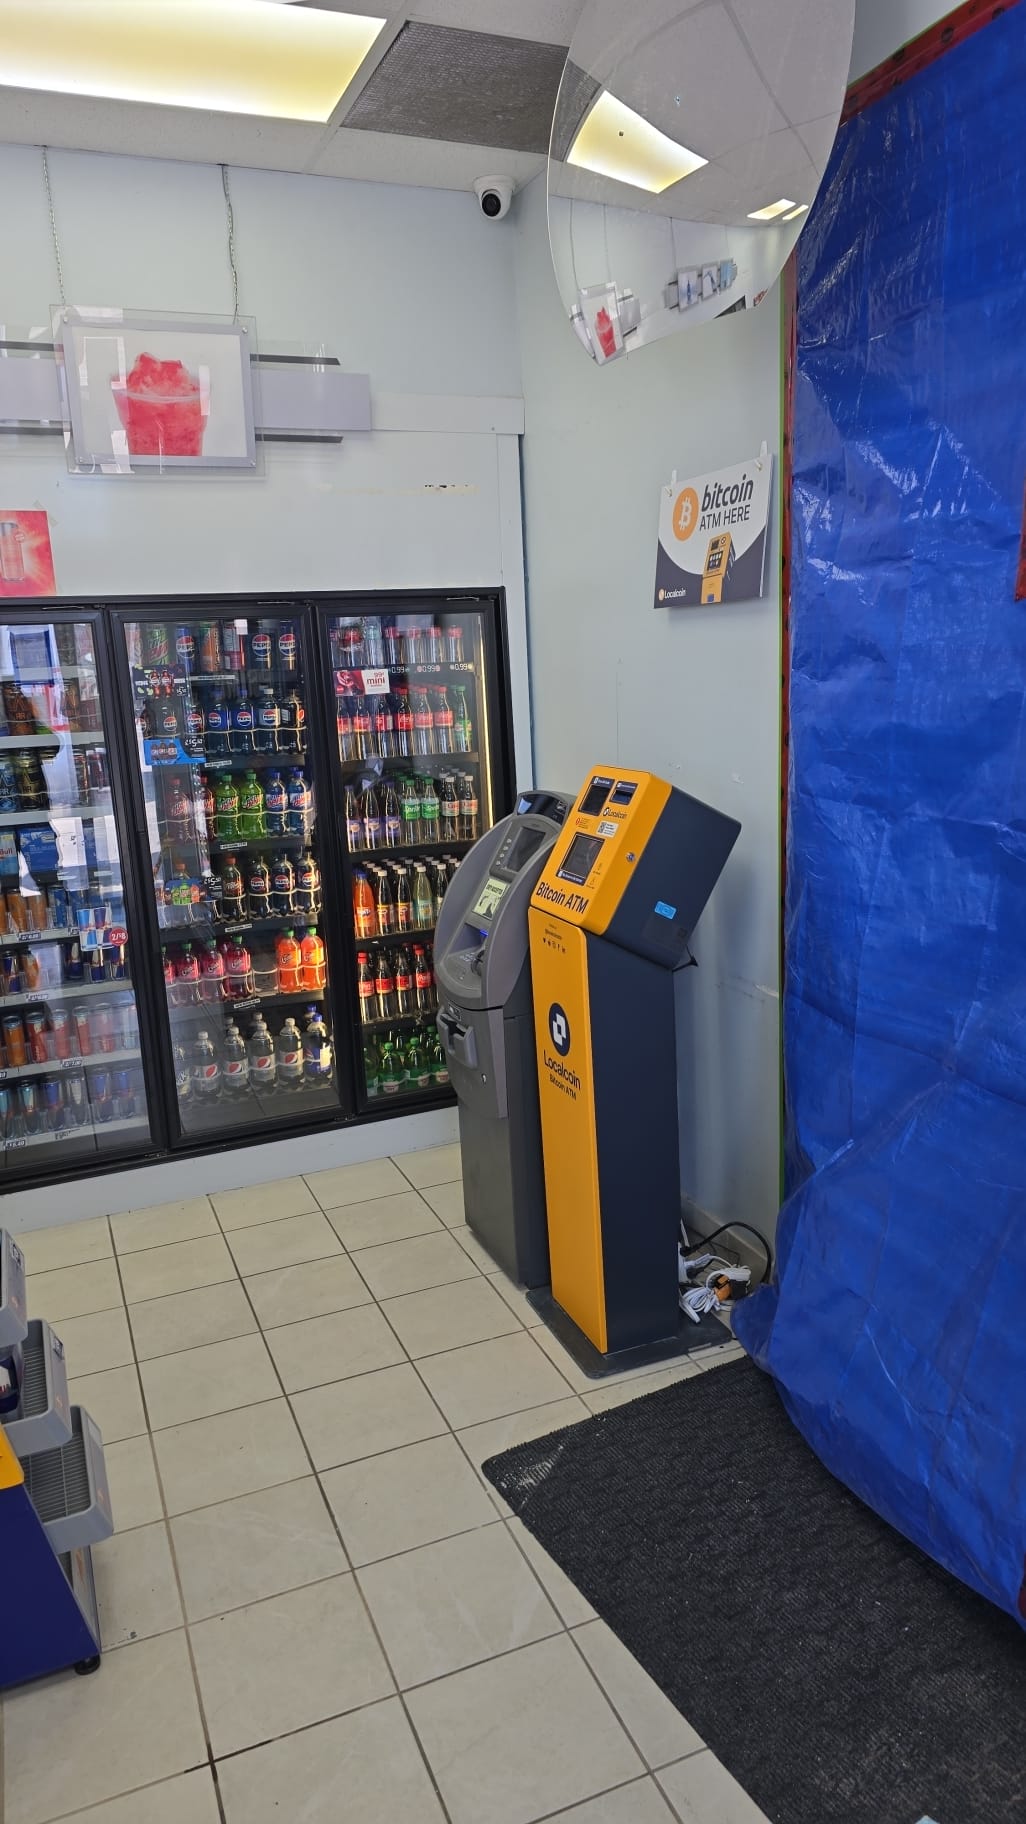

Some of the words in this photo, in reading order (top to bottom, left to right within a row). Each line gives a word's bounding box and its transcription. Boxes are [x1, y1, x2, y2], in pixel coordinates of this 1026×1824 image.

[701, 473, 754, 512] bitcoin
[700, 511, 723, 532] ATM
[723, 504, 751, 525] HERE
[366, 677, 385, 685] mini
[536, 881, 566, 906] Bitcoin
[565, 893, 589, 914] ATM
[543, 1049, 581, 1090] Localcoin
